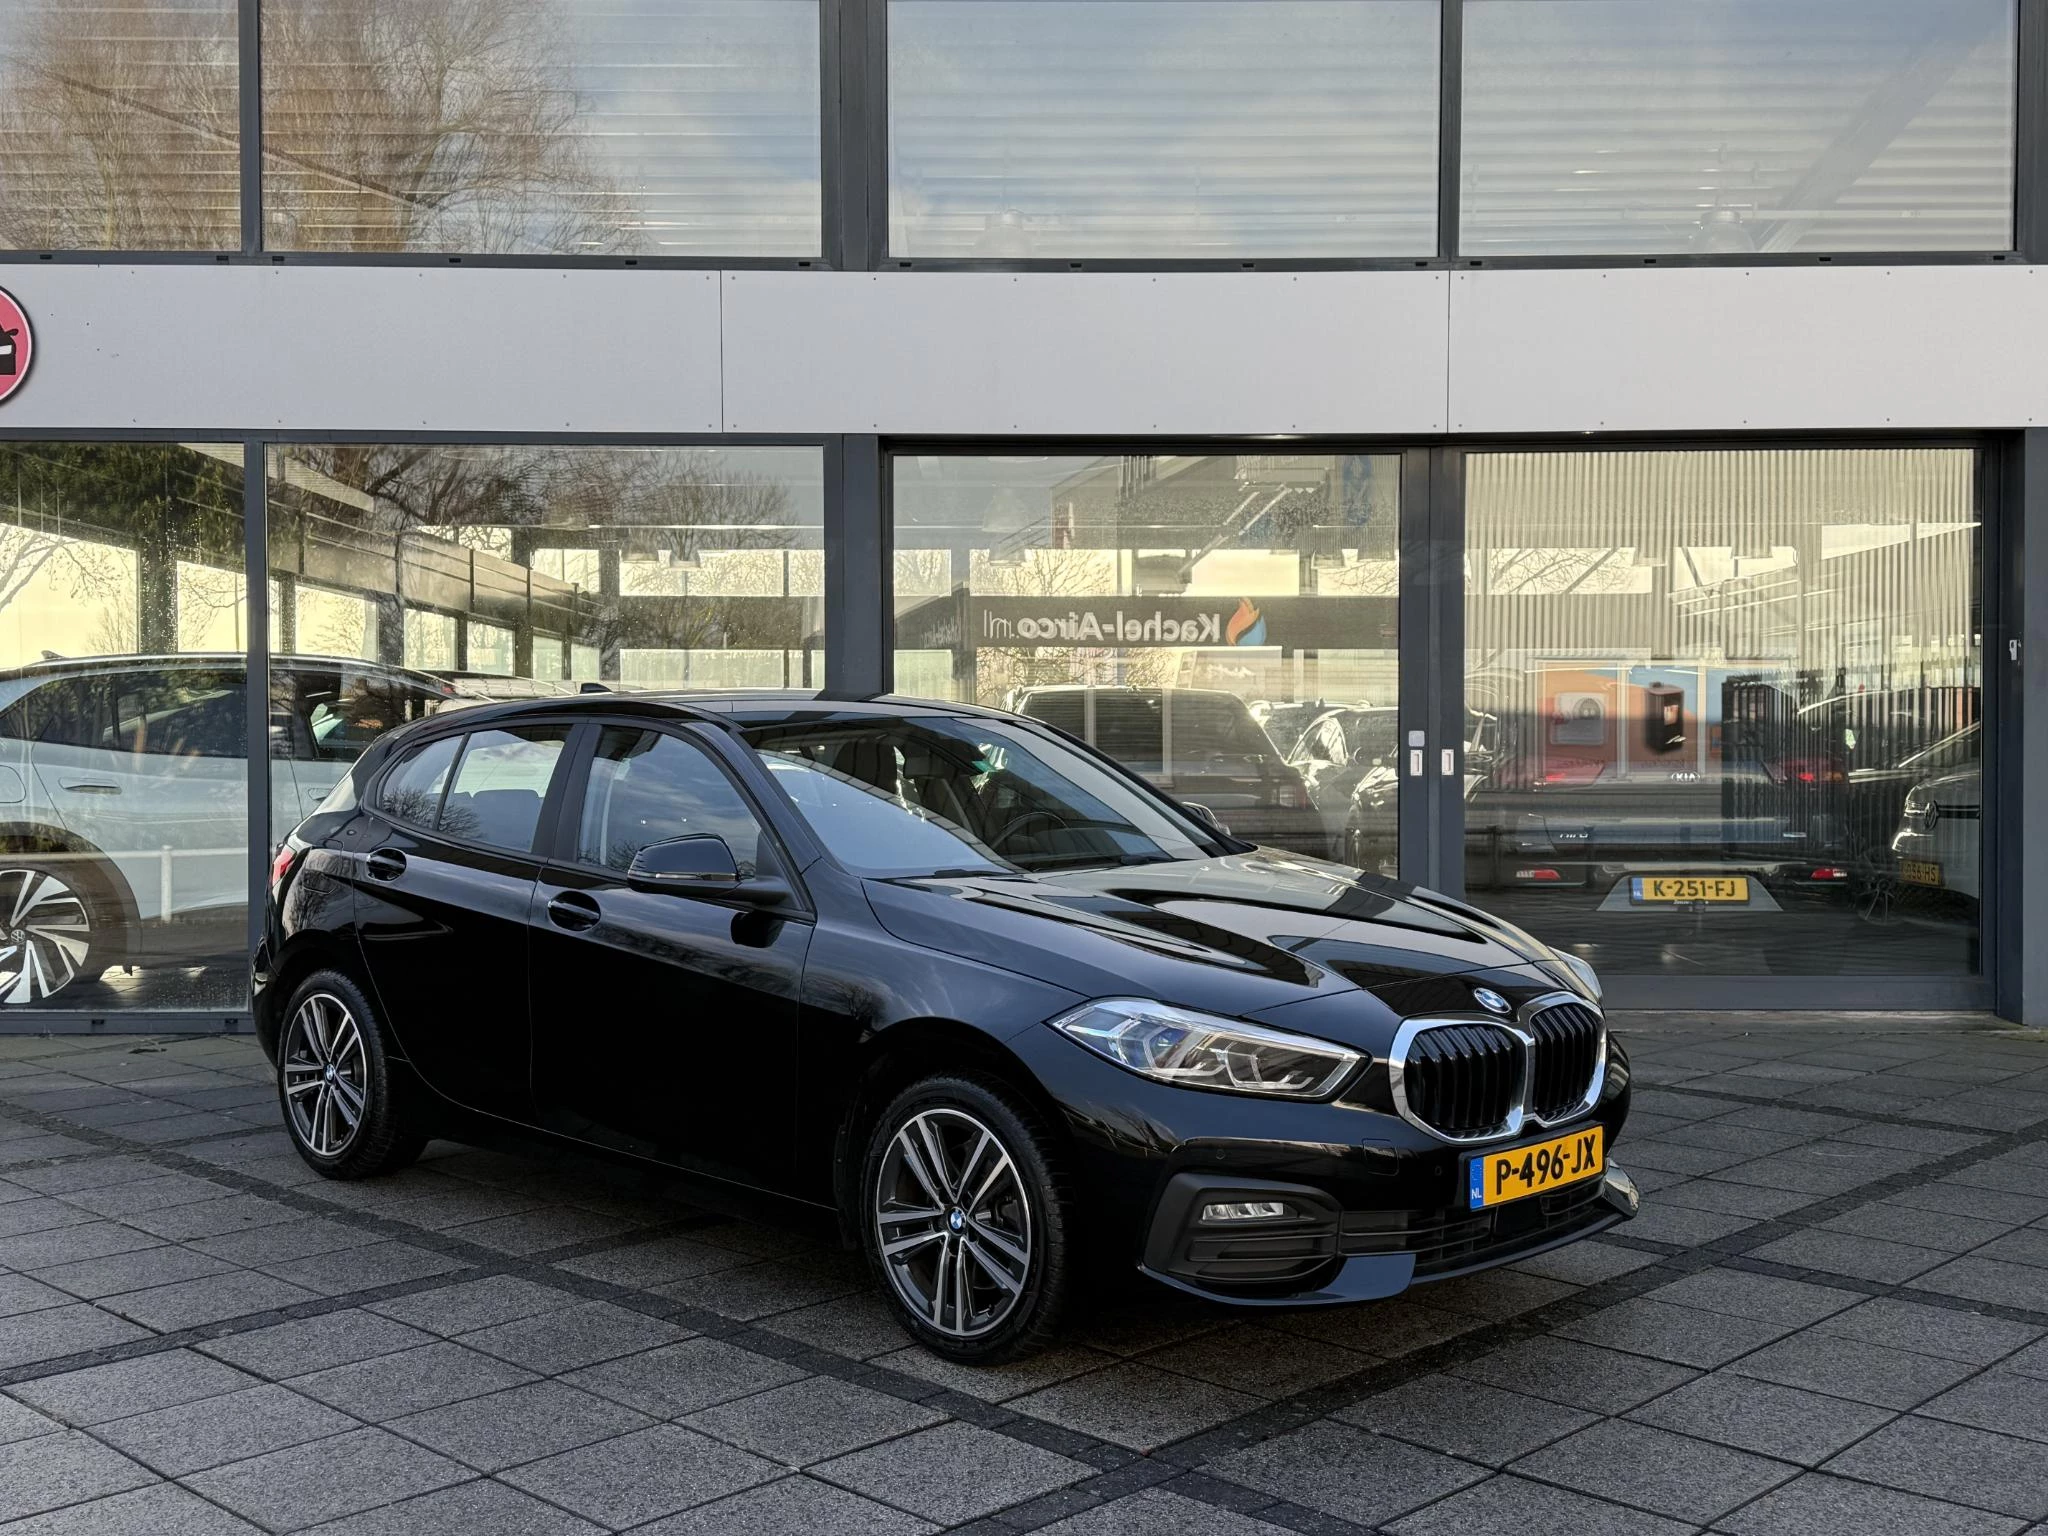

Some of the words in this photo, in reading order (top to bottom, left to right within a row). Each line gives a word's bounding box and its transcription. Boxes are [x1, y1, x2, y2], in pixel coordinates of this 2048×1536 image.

[1653, 880, 1736, 897] K-251-FJ
[1496, 1133, 1596, 1196] P-496-JX
[1471, 1188, 1483, 1200] NL
